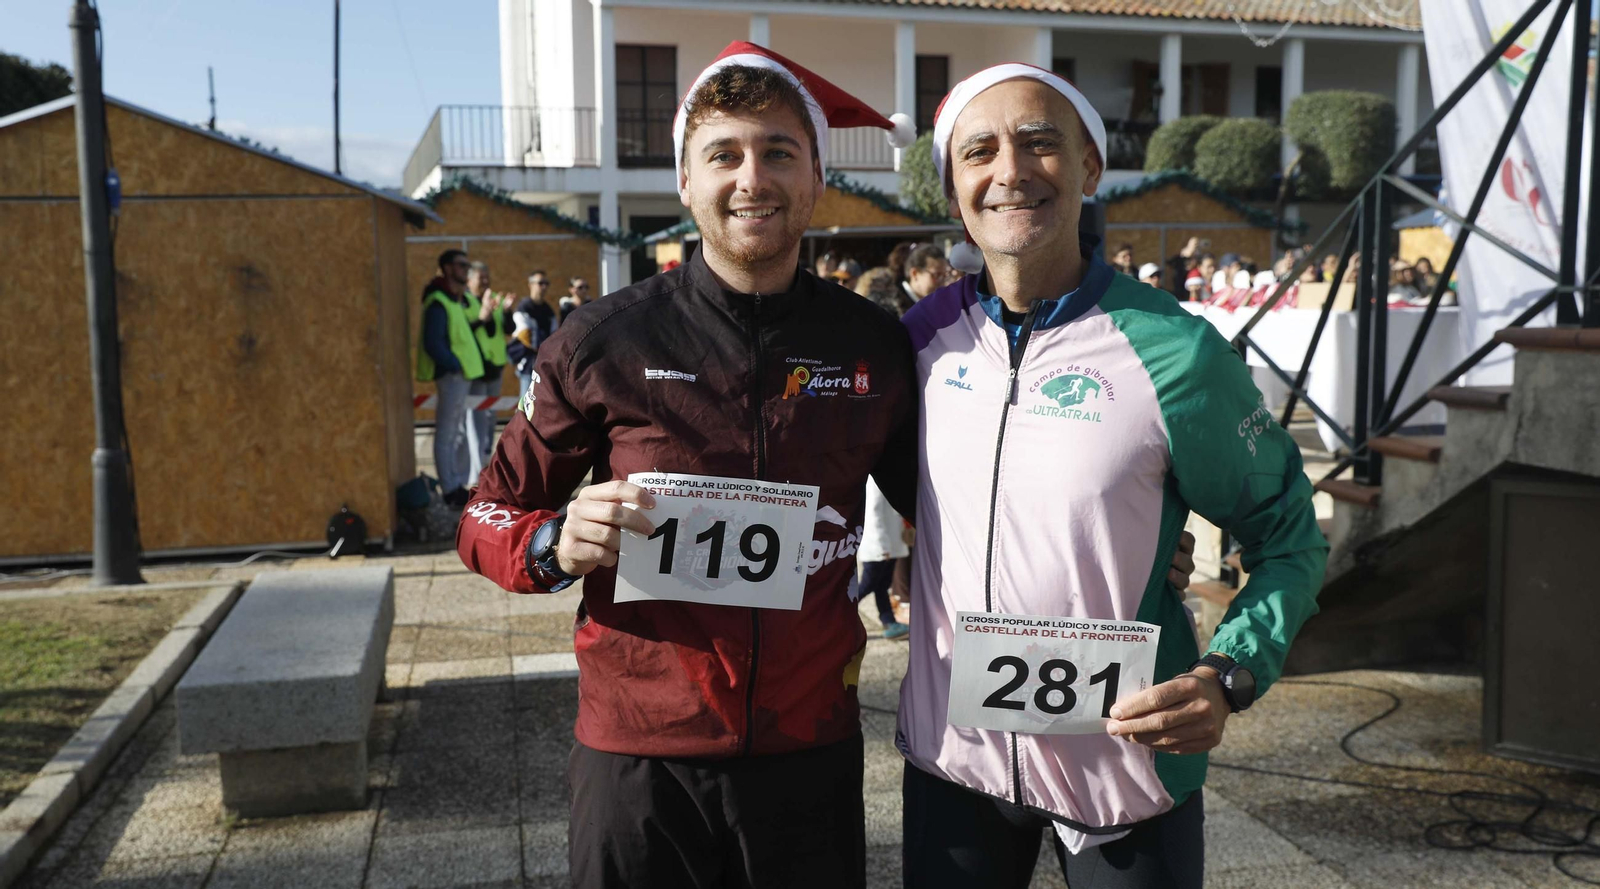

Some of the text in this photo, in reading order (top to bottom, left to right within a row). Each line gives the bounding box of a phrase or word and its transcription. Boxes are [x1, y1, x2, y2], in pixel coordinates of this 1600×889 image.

[807, 373, 852, 390] Álora
[944, 378, 973, 391] SPALL
[1029, 368, 1062, 393] campo
[1067, 364, 1081, 372] de
[1083, 367, 1115, 402] gibraltar
[1033, 404, 1102, 423] ULTRATRAIL
[636, 477, 667, 486] CROSS
[668, 479, 715, 489] POPULAR
[716, 481, 753, 492] LÚDICO
[762, 487, 814, 498] SOLIDARIO
[706, 491, 723, 500] DE
[725, 492, 741, 501] LA
[743, 493, 807, 508] FRONTERA
[648, 518, 780, 583] 119
[965, 624, 1148, 643] CASTELLAR DE LA FRONTERA
[966, 616, 1000, 624] CROSS
[1002, 618, 1050, 627] POPULAR
[1052, 620, 1090, 630] LÚDICO
[1100, 624, 1154, 633] SOLIDARIO
[982, 655, 1122, 719] 281
